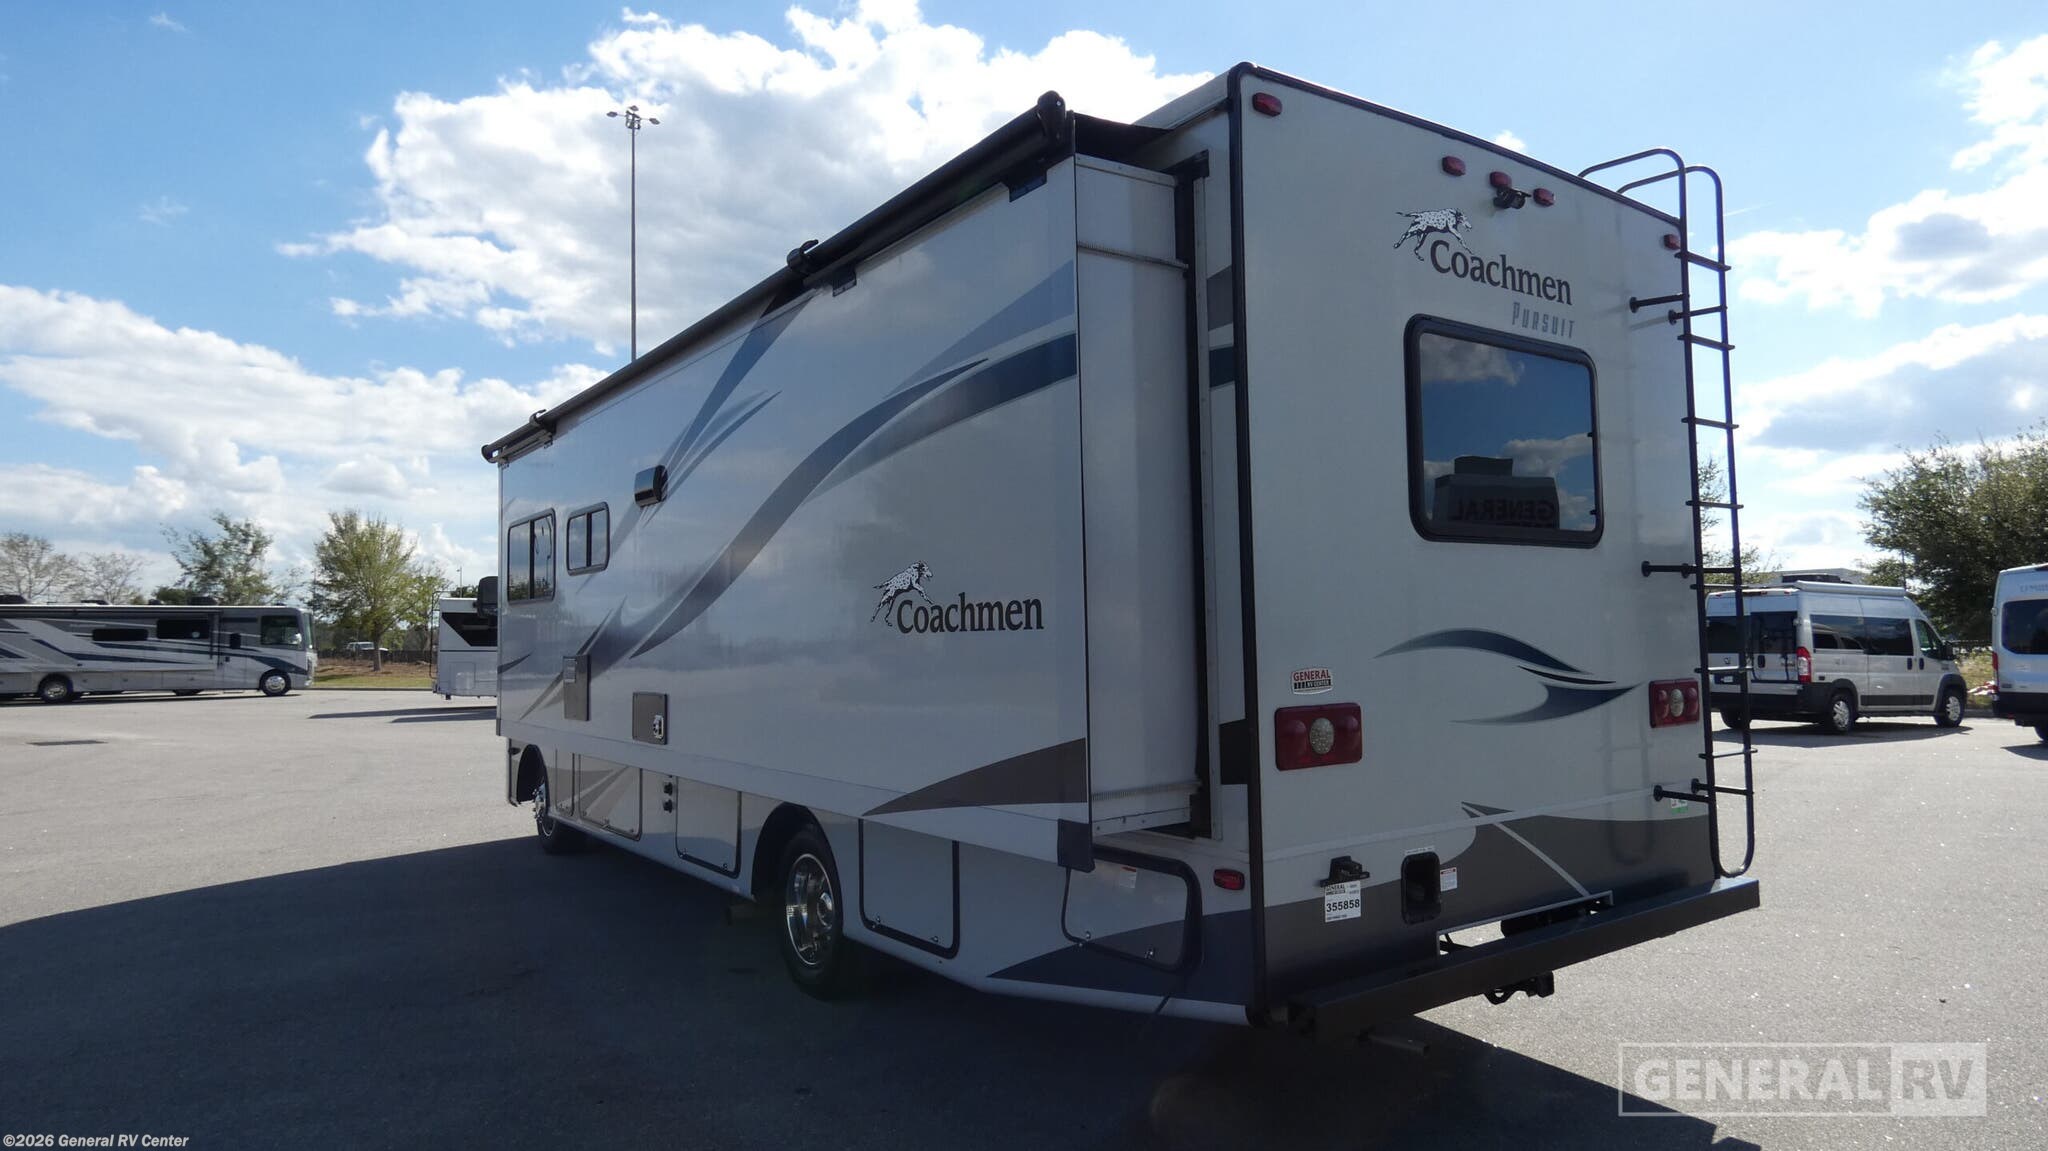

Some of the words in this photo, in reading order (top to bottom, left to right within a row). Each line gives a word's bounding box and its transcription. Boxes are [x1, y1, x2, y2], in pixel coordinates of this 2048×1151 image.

[1430, 239, 1573, 306] Coachmen
[1511, 301, 1576, 339] PURSUIT
[896, 591, 1045, 634] Coachmen
[1293, 669, 1331, 681] GENERAL
[1326, 898, 1360, 912] 355858
